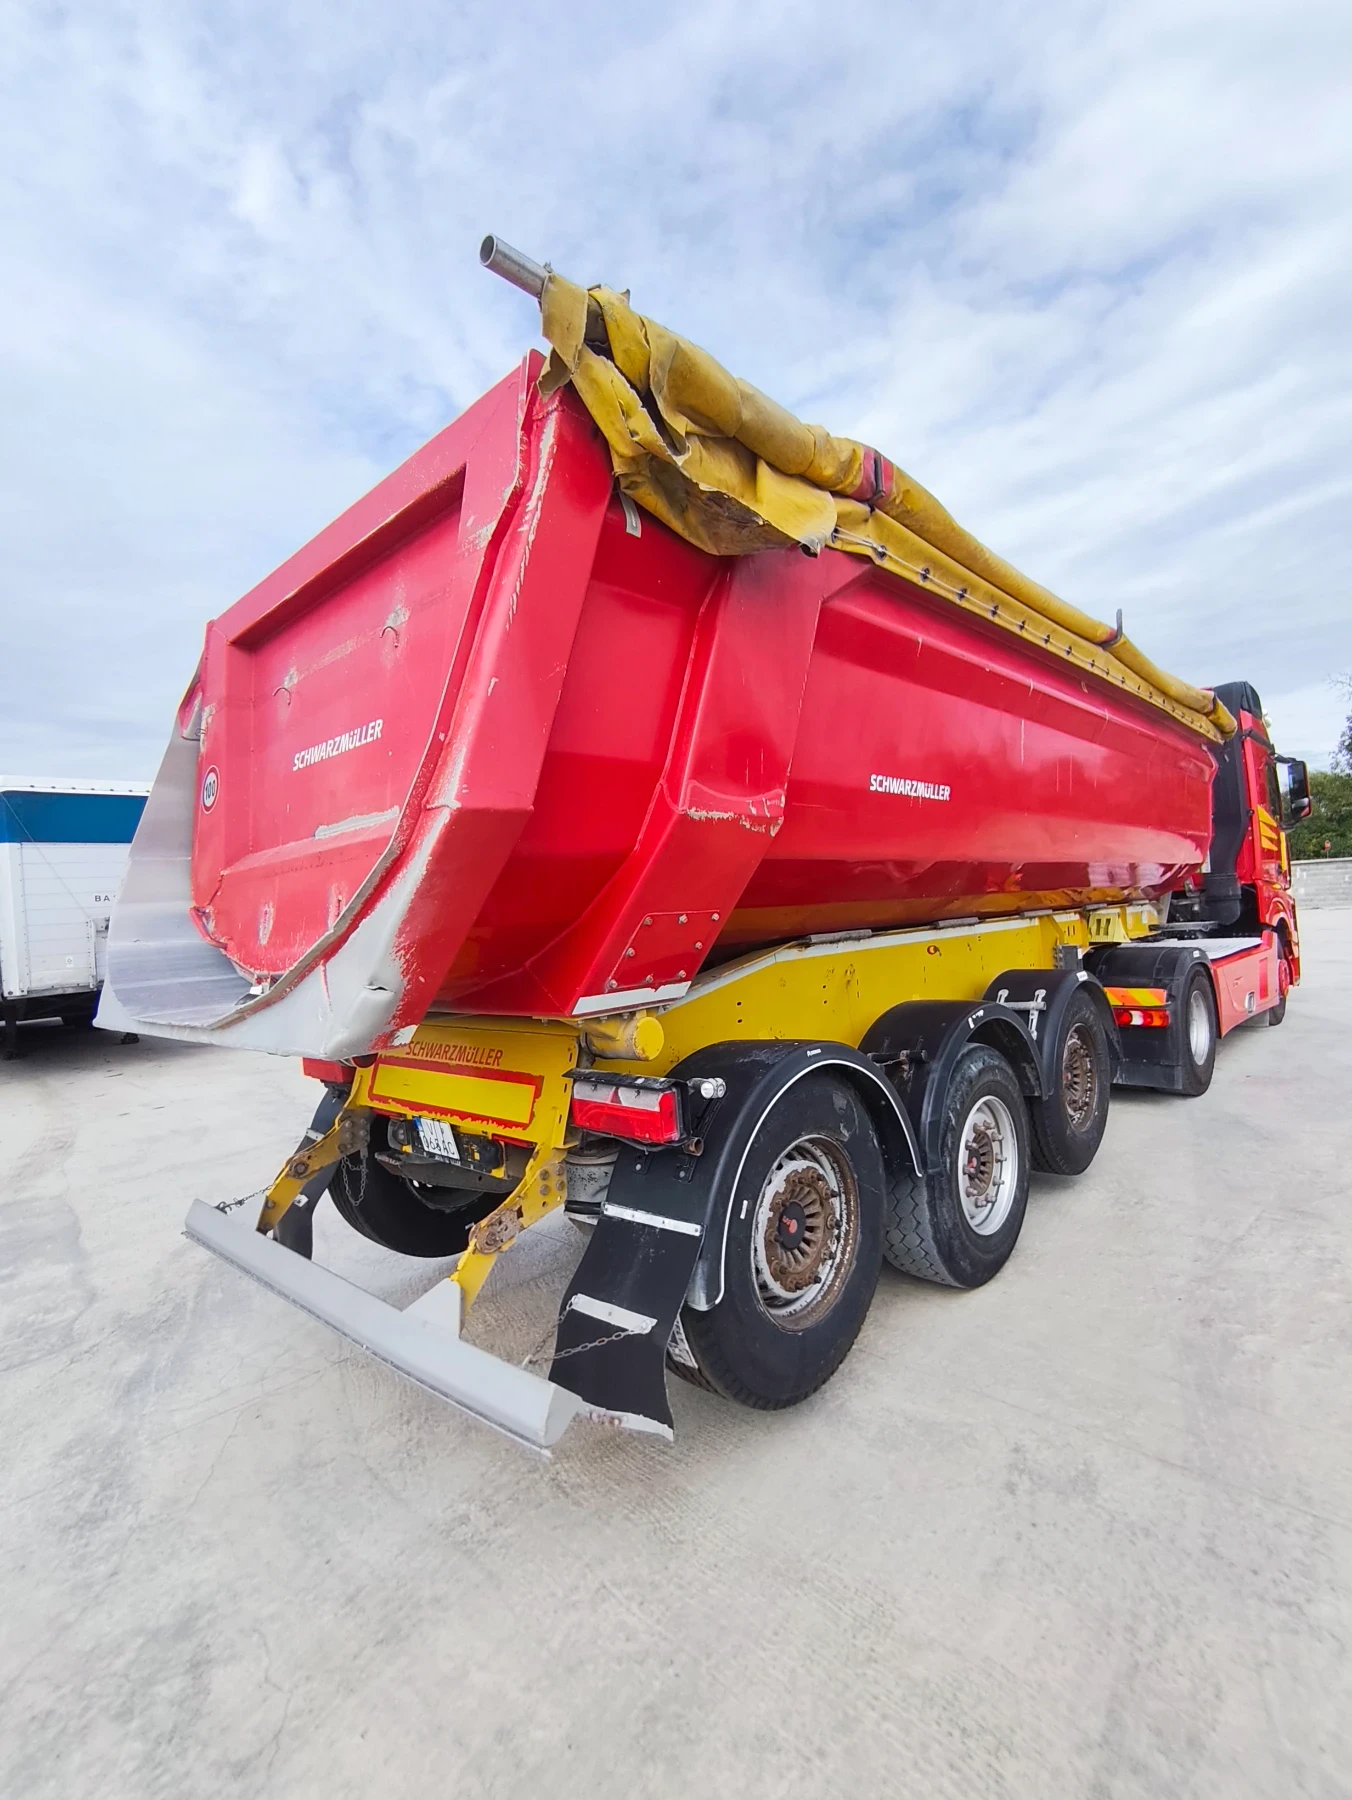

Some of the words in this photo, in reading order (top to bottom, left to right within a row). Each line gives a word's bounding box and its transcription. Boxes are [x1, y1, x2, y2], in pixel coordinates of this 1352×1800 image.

[293, 719, 384, 771] SCHWARZMÜLLER
[204, 779, 216, 800] 100
[869, 773, 951, 801] SCHWARZMÜLLER
[94, 894, 116, 902] BA
[406, 1040, 503, 1067] SCHWARZMÜLLER
